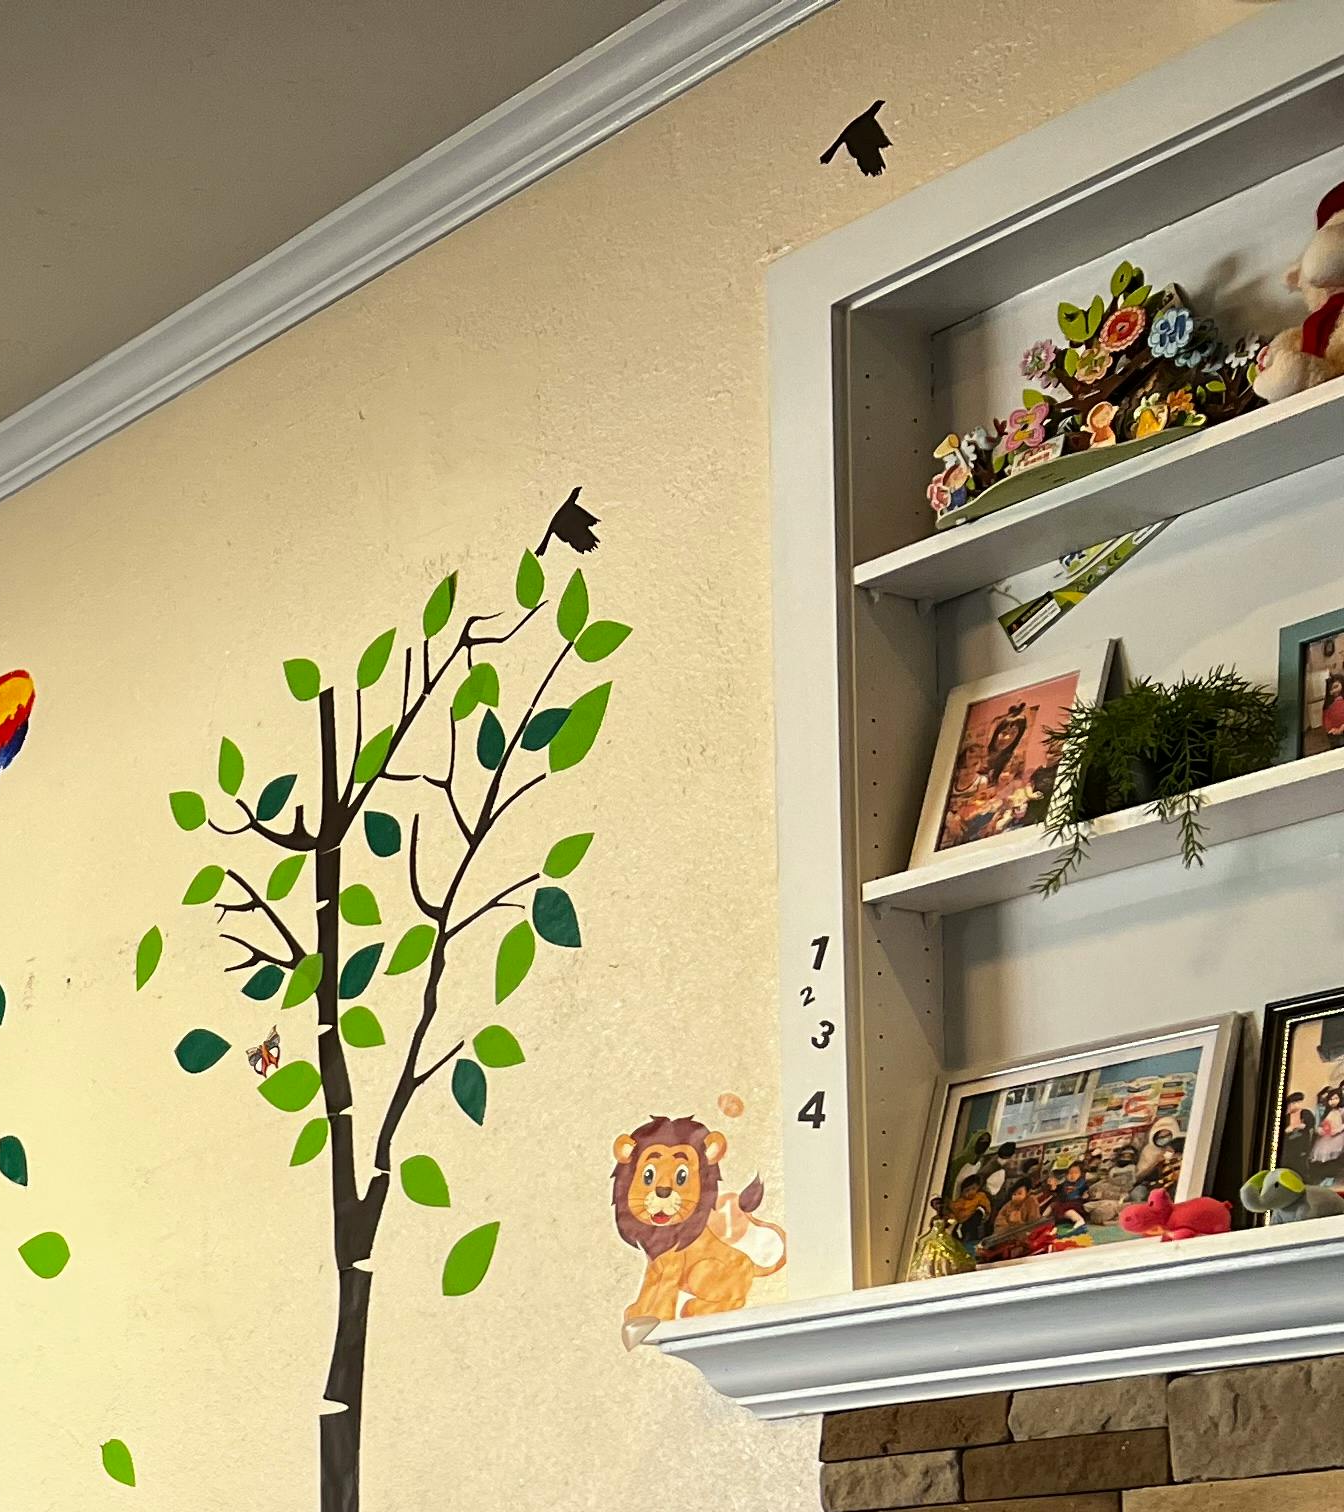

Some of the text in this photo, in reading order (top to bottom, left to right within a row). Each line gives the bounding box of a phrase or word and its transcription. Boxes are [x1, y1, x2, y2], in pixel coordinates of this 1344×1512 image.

[810, 936, 830, 971] 1
[799, 986, 816, 1007] 2
[811, 1020, 835, 1049] 3
[797, 1091, 827, 1129] 4
